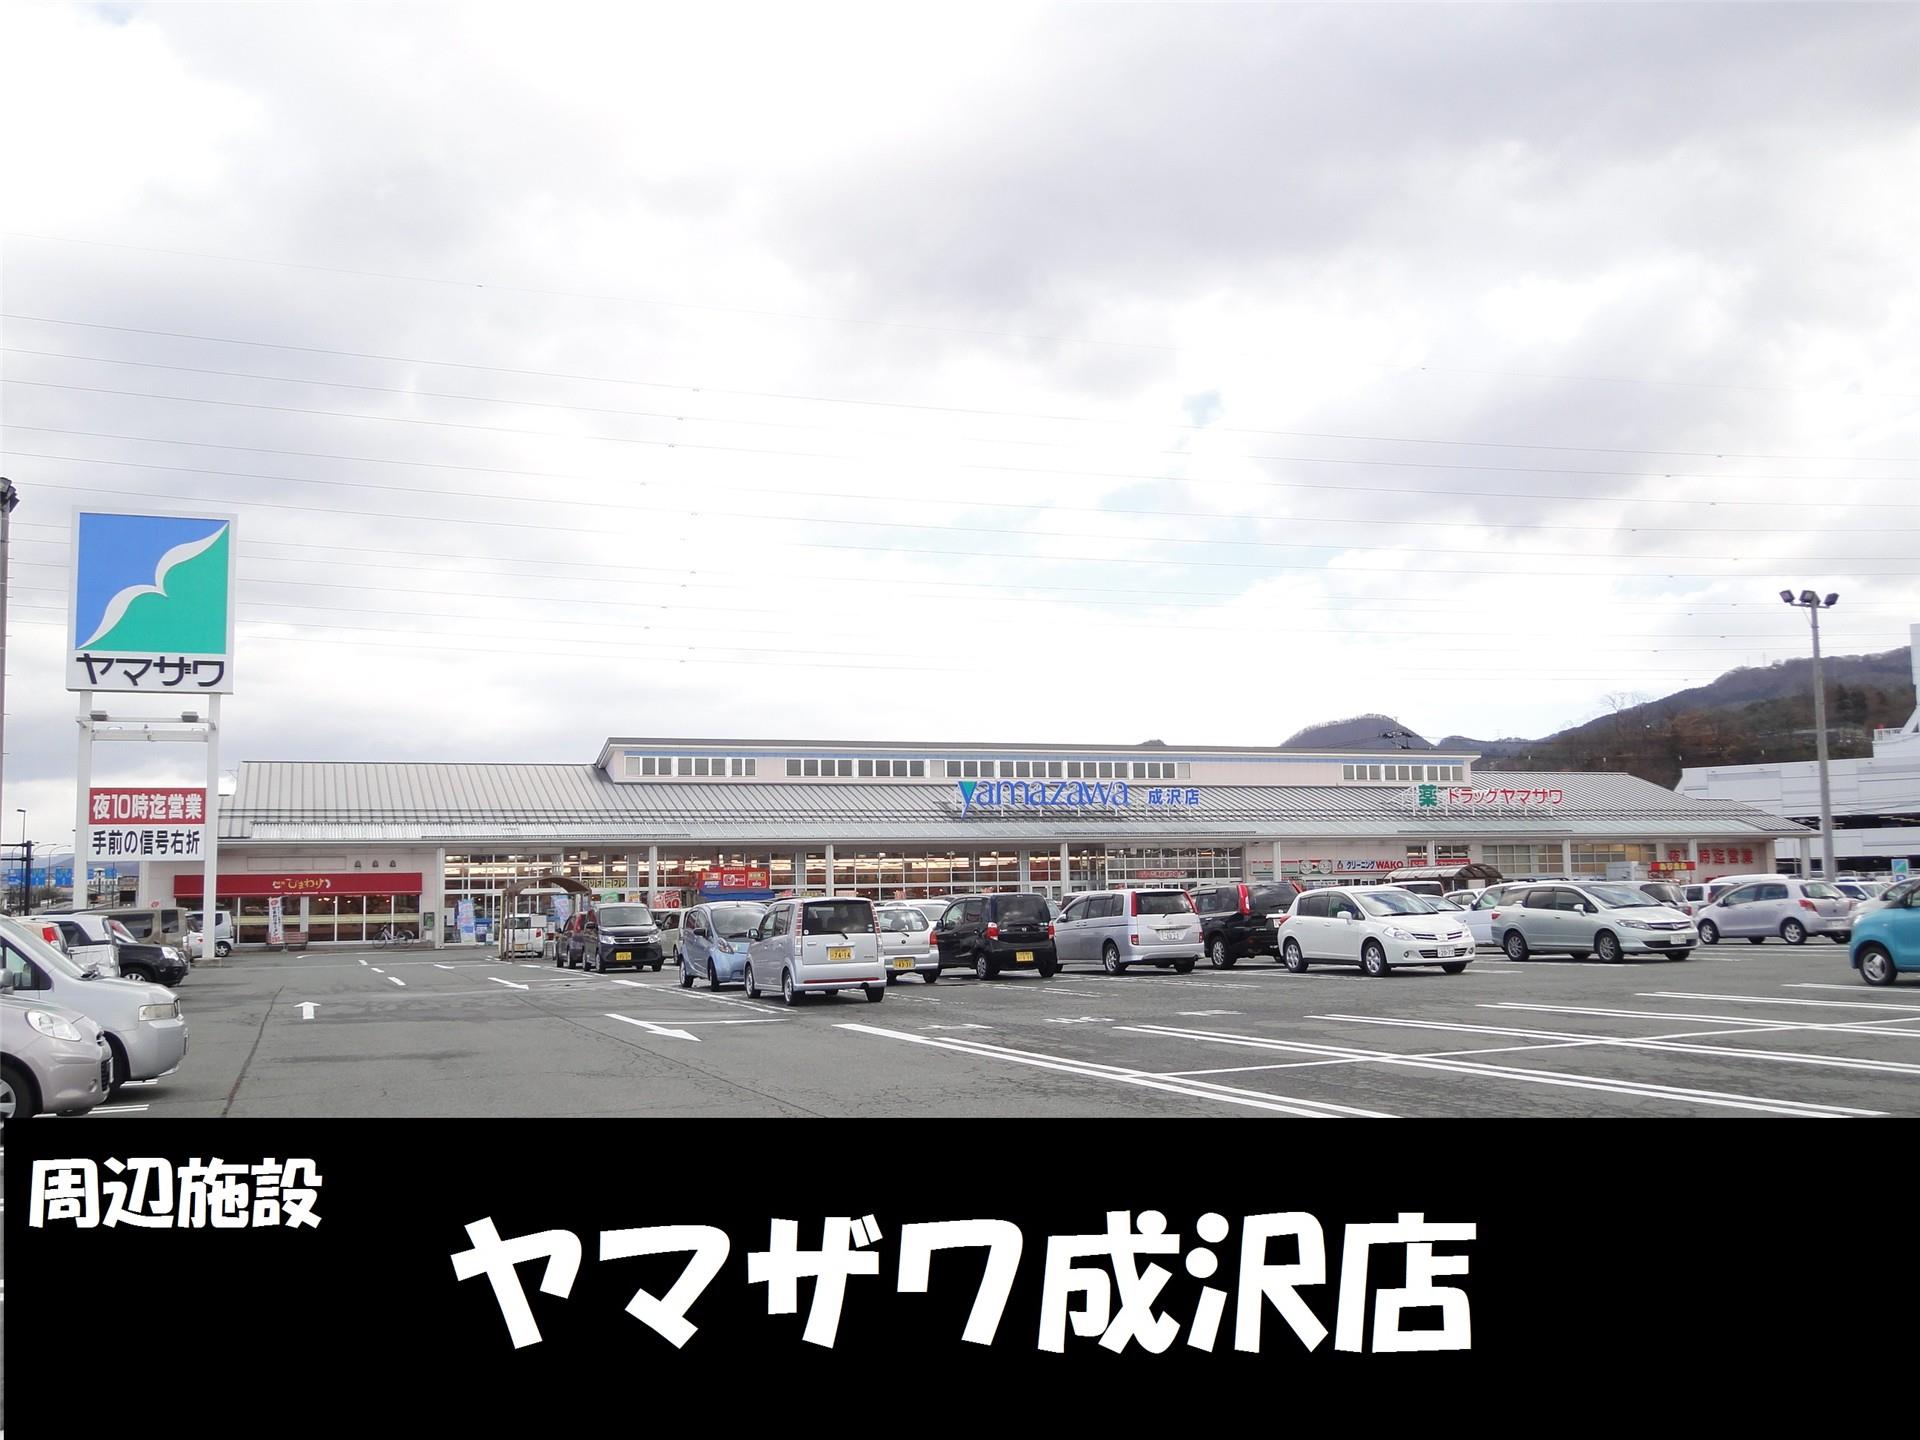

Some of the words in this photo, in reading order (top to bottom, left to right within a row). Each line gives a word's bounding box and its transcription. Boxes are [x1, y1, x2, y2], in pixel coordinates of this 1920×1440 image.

[76, 653, 225, 687] ヤマザワ
[93, 793, 202, 819] 夜10時迄営業
[958, 780, 1129, 818] yamazawa
[1148, 788, 1200, 806] 成沢店
[1418, 784, 1438, 807] 薬
[92, 829, 200, 855] 手前の信号右折
[1346, 860, 1375, 870] クリーニング
[1375, 860, 1404, 869] WAKO
